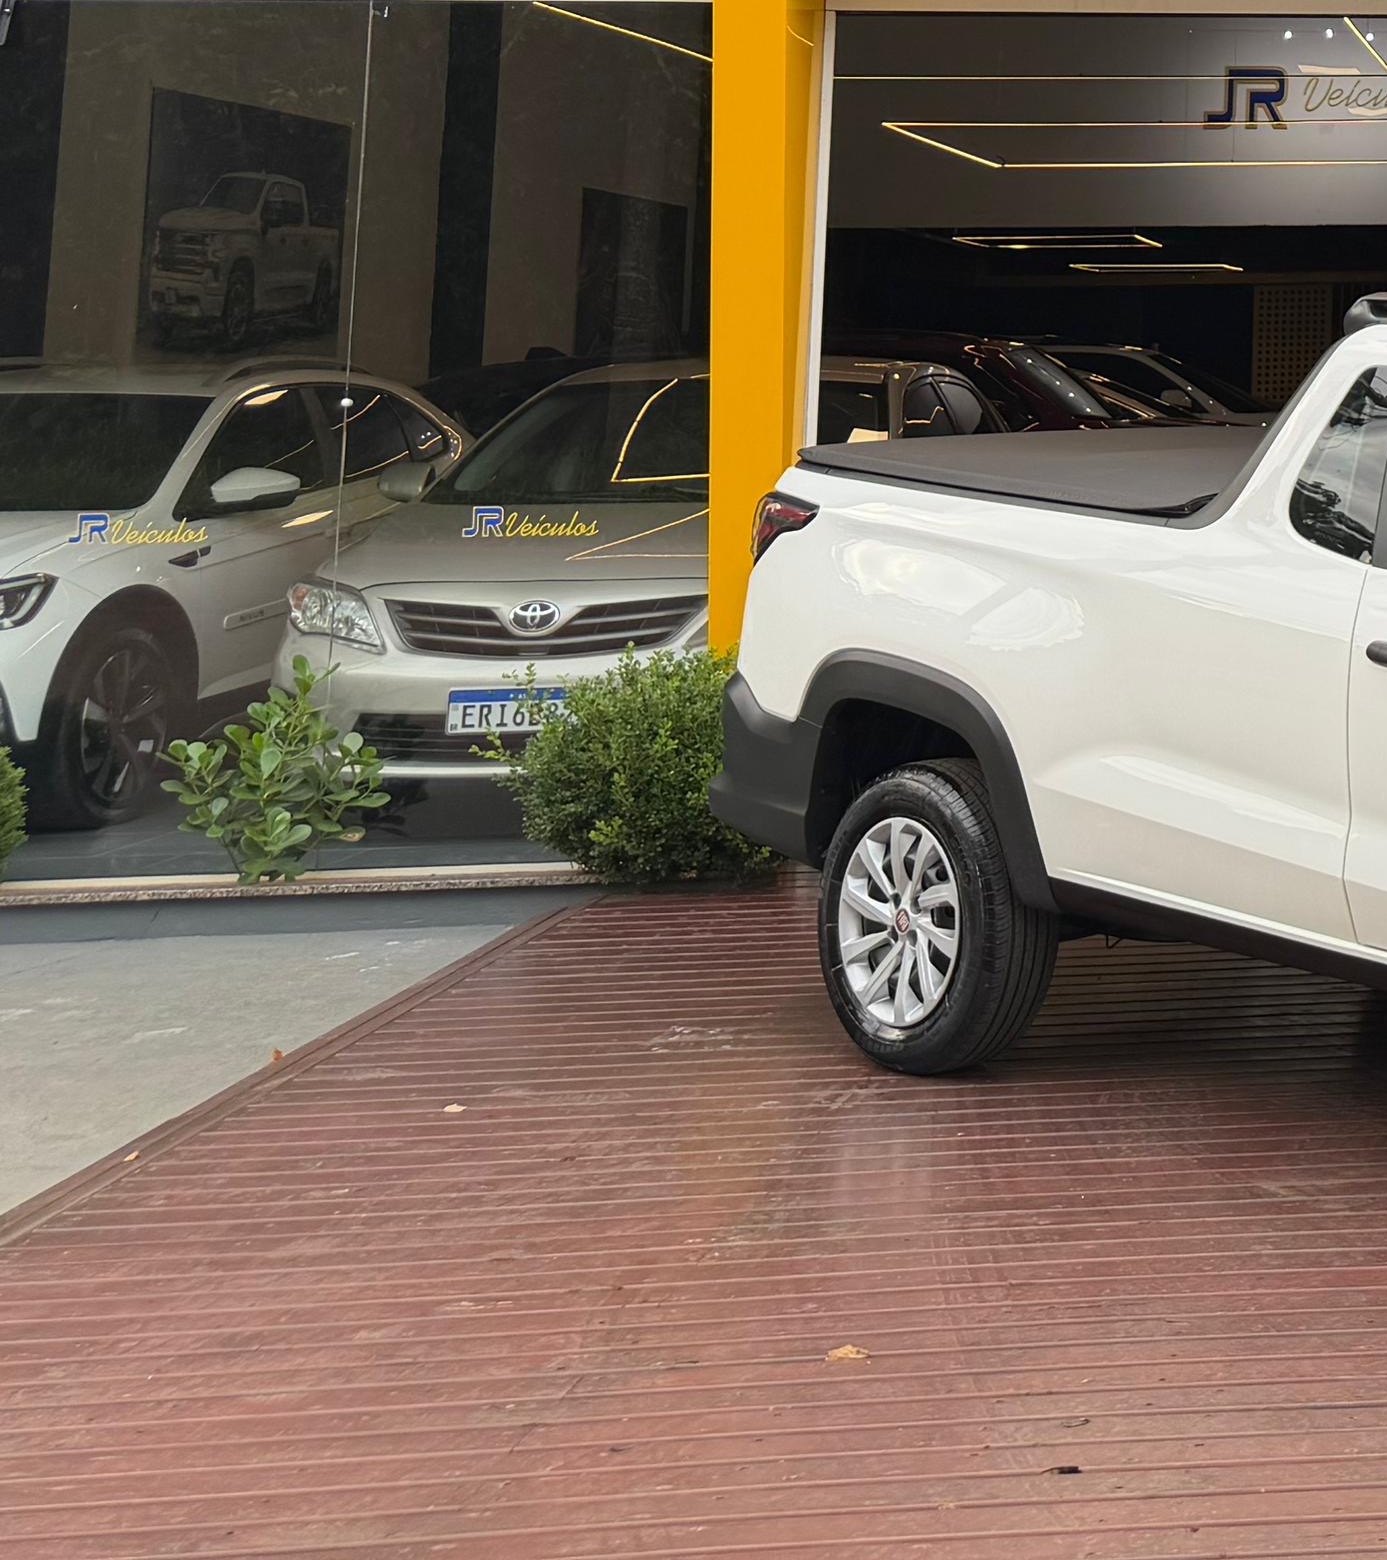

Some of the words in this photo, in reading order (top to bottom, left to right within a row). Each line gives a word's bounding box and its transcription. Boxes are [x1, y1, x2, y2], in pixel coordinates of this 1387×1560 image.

[1203, 66, 1288, 130] JR
[68, 512, 111, 545] JR
[462, 505, 505, 538] JR
